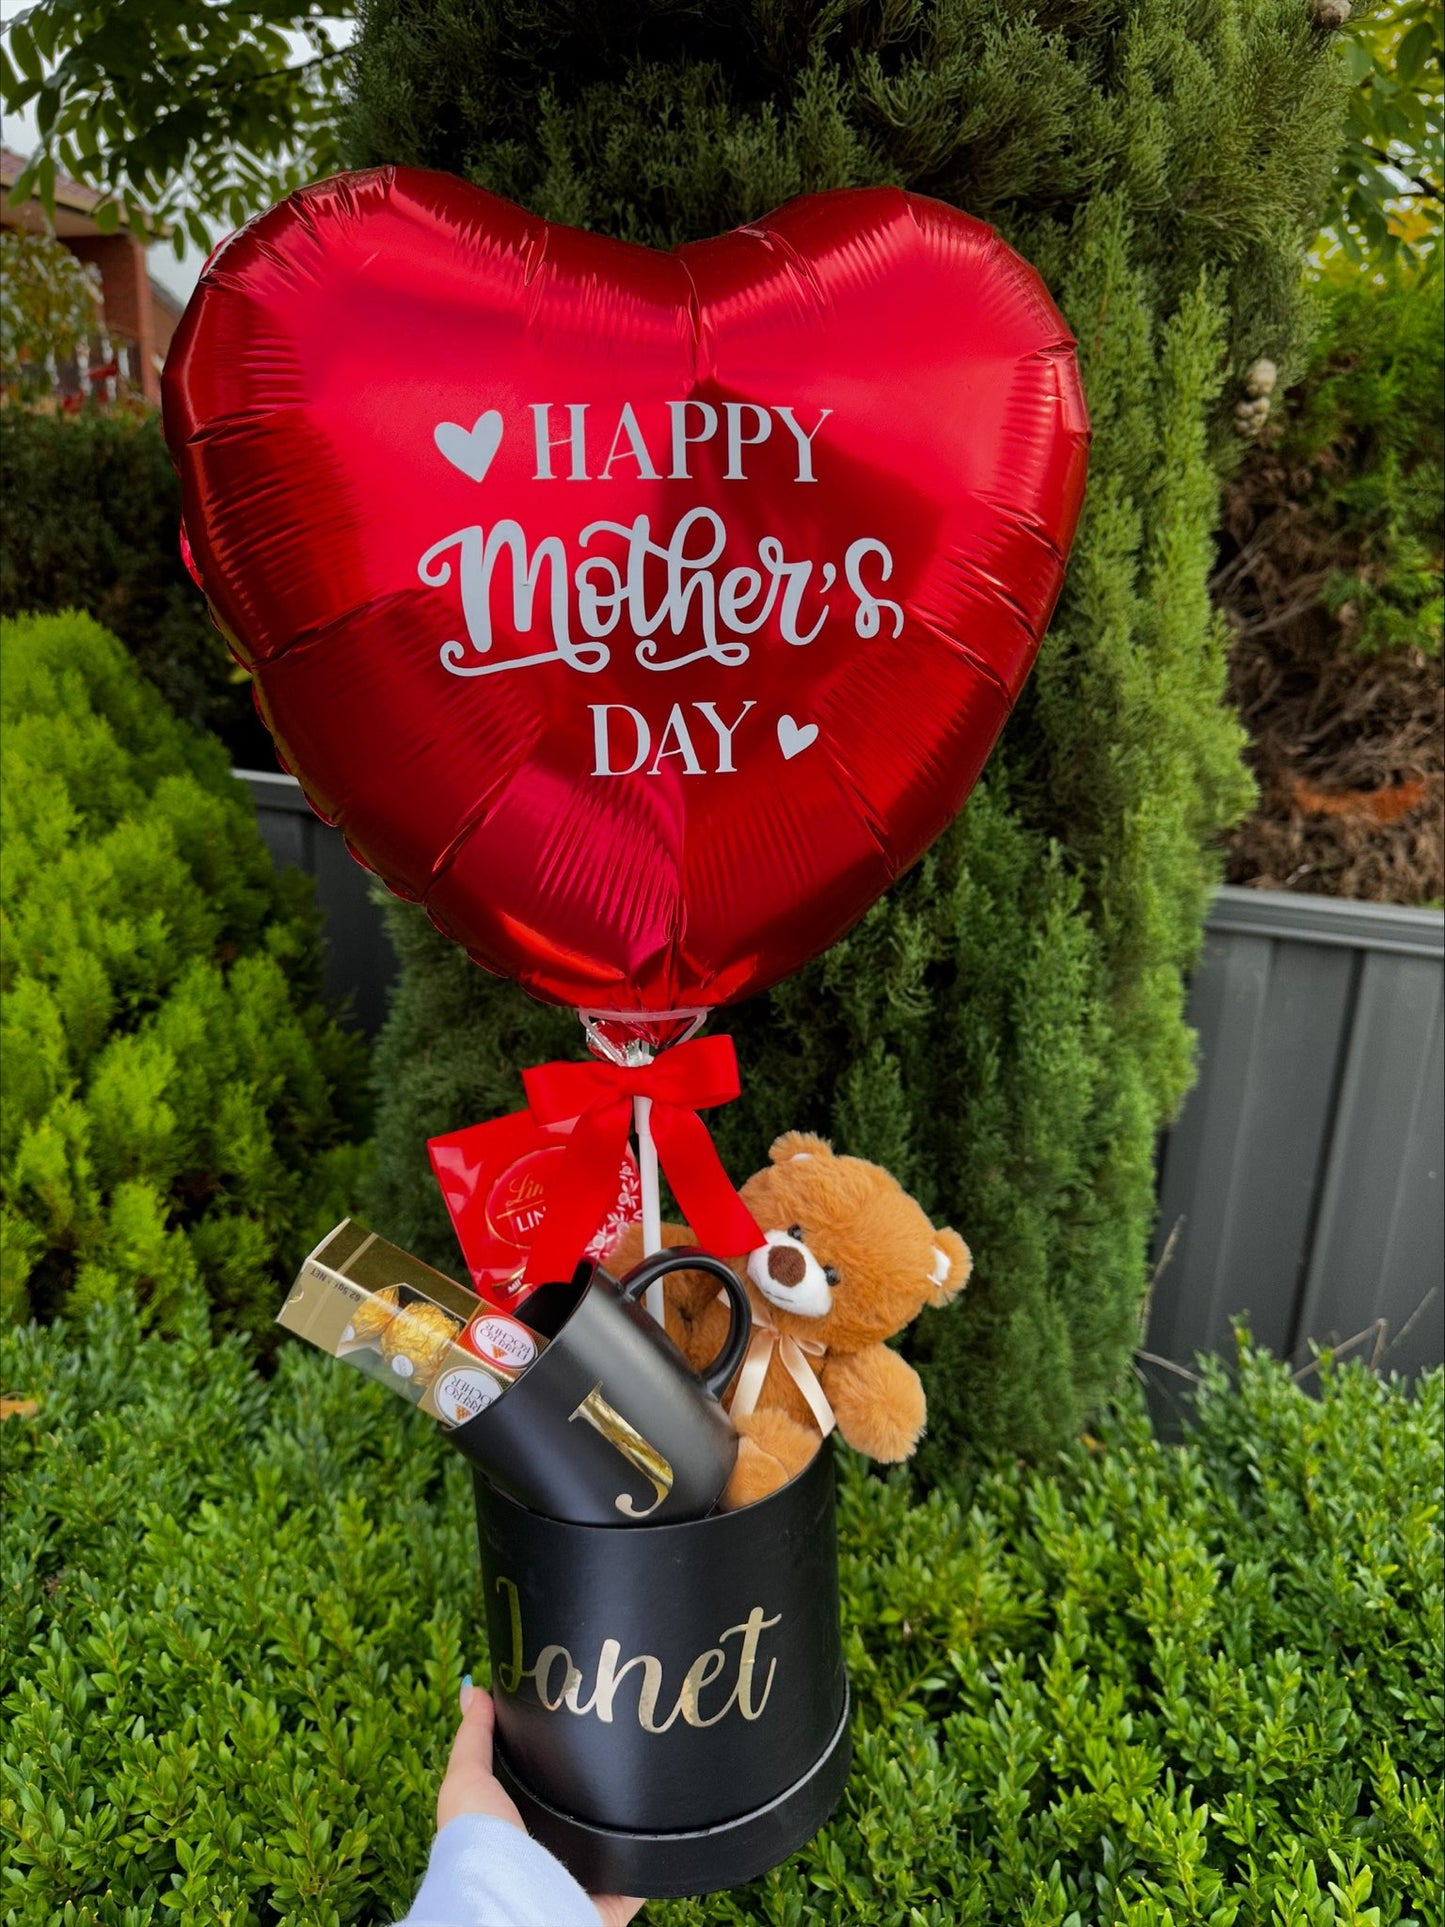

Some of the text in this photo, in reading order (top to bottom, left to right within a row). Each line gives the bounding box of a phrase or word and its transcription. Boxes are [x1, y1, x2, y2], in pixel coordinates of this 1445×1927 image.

[528, 400, 833, 482] HAPPY
[417, 506, 904, 677] Mother's
[587, 700, 757, 776] DAY
[505, 1172, 544, 1207] Lin
[515, 1205, 547, 1233] LIN
[480, 1327, 529, 1361] FERRERO
[485, 1320, 532, 1354] ROCHER
[444, 1384, 483, 1413] RRERO
[451, 1374, 494, 1406] OCHER
[567, 1380, 674, 1518] J
[496, 1575, 783, 1734] Janet
